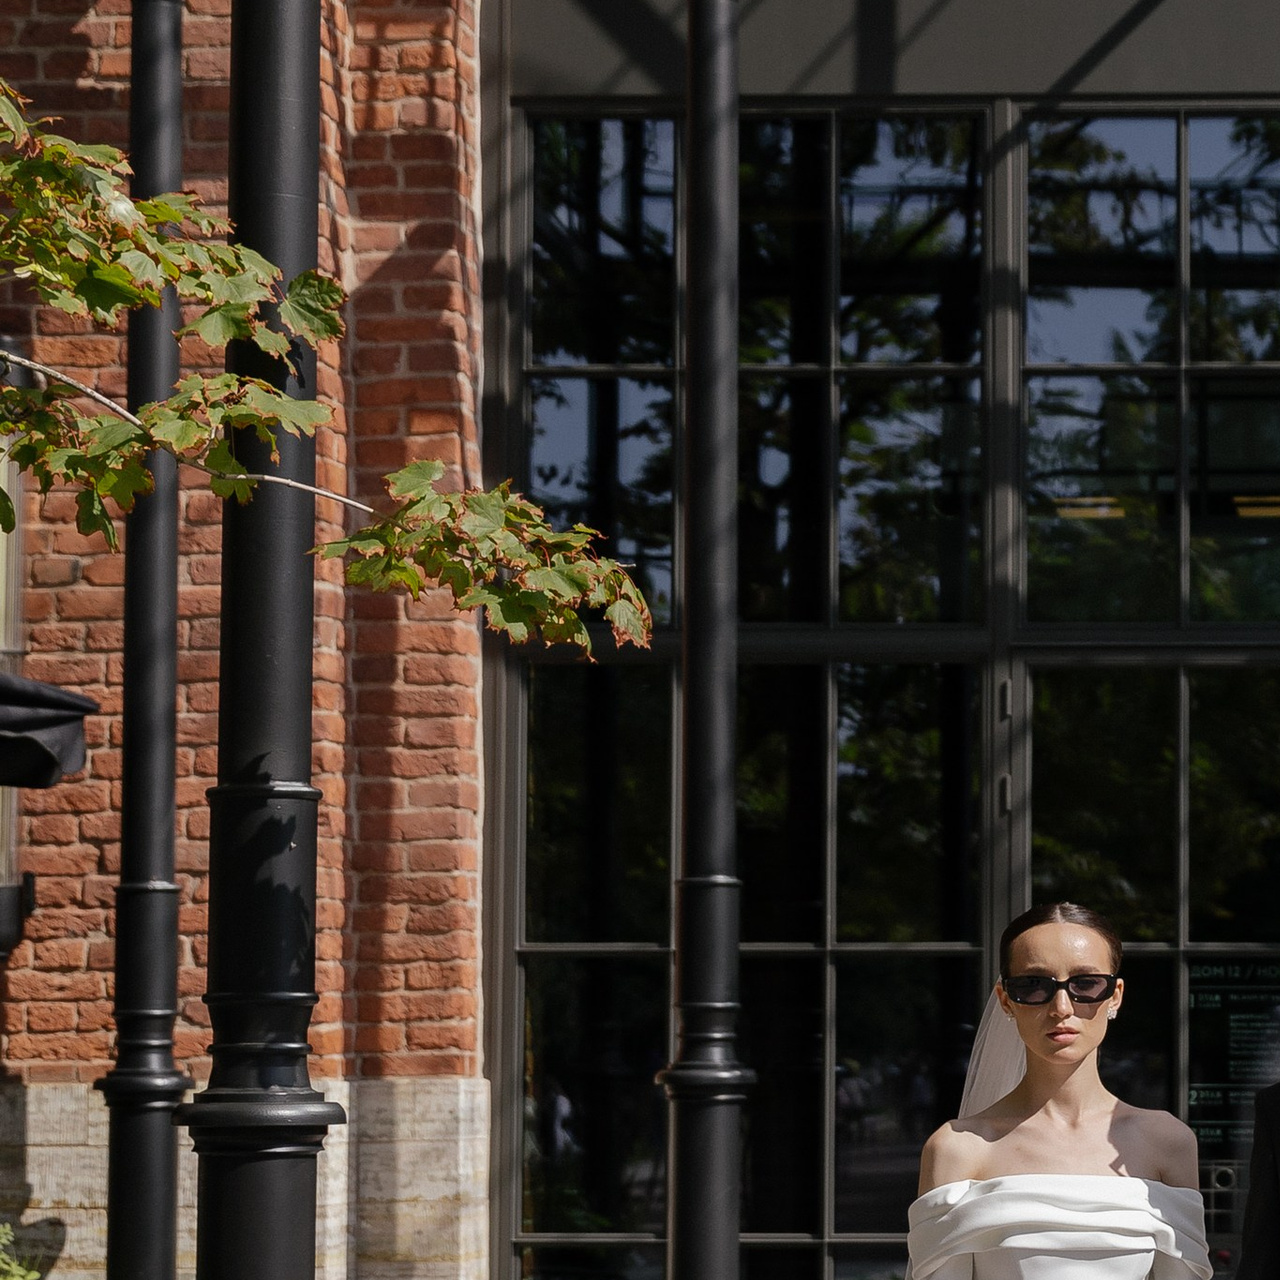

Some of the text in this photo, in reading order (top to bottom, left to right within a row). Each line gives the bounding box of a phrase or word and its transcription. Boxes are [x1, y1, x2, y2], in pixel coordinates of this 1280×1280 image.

[1190, 965, 1225, 978] ДОМ
[1228, 965, 1242, 977] 12
[1188, 1089, 1198, 1105] 2
